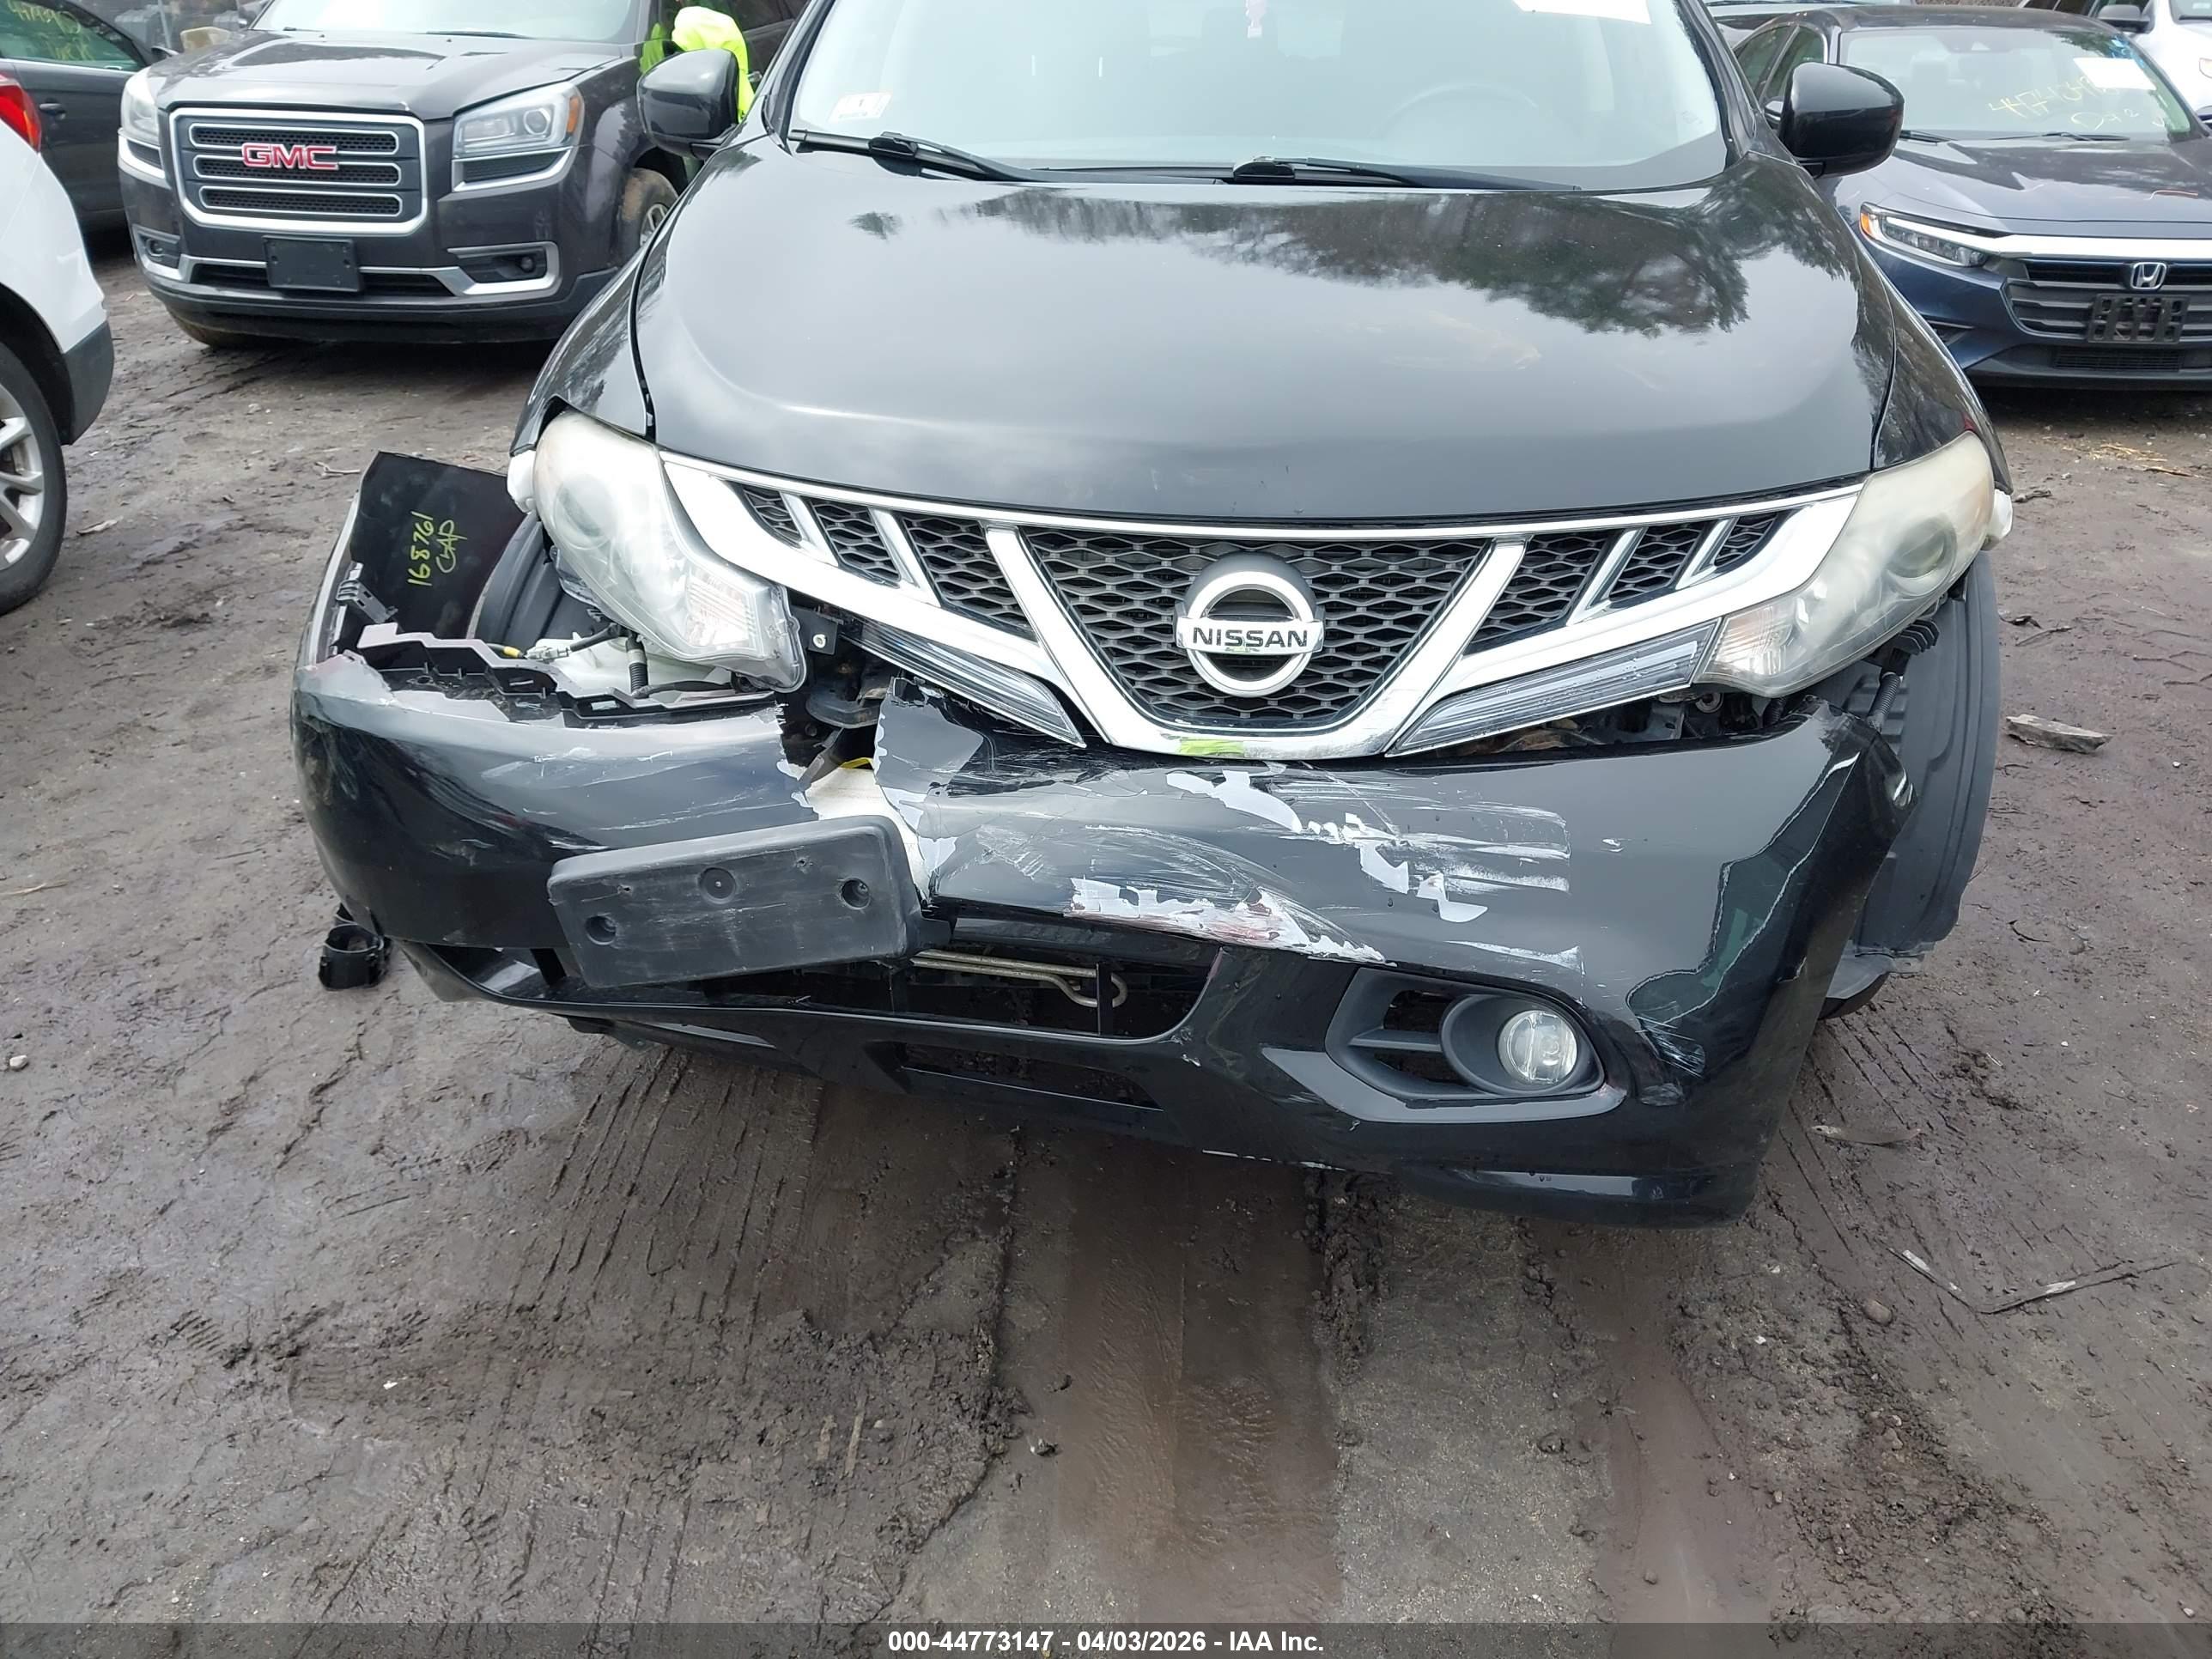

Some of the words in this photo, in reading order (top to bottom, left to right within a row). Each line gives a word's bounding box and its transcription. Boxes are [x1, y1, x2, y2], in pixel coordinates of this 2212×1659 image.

[241, 143, 338, 170] GMC
[408, 511, 434, 586] 168761
[1193, 627, 1308, 647] NISSAN
